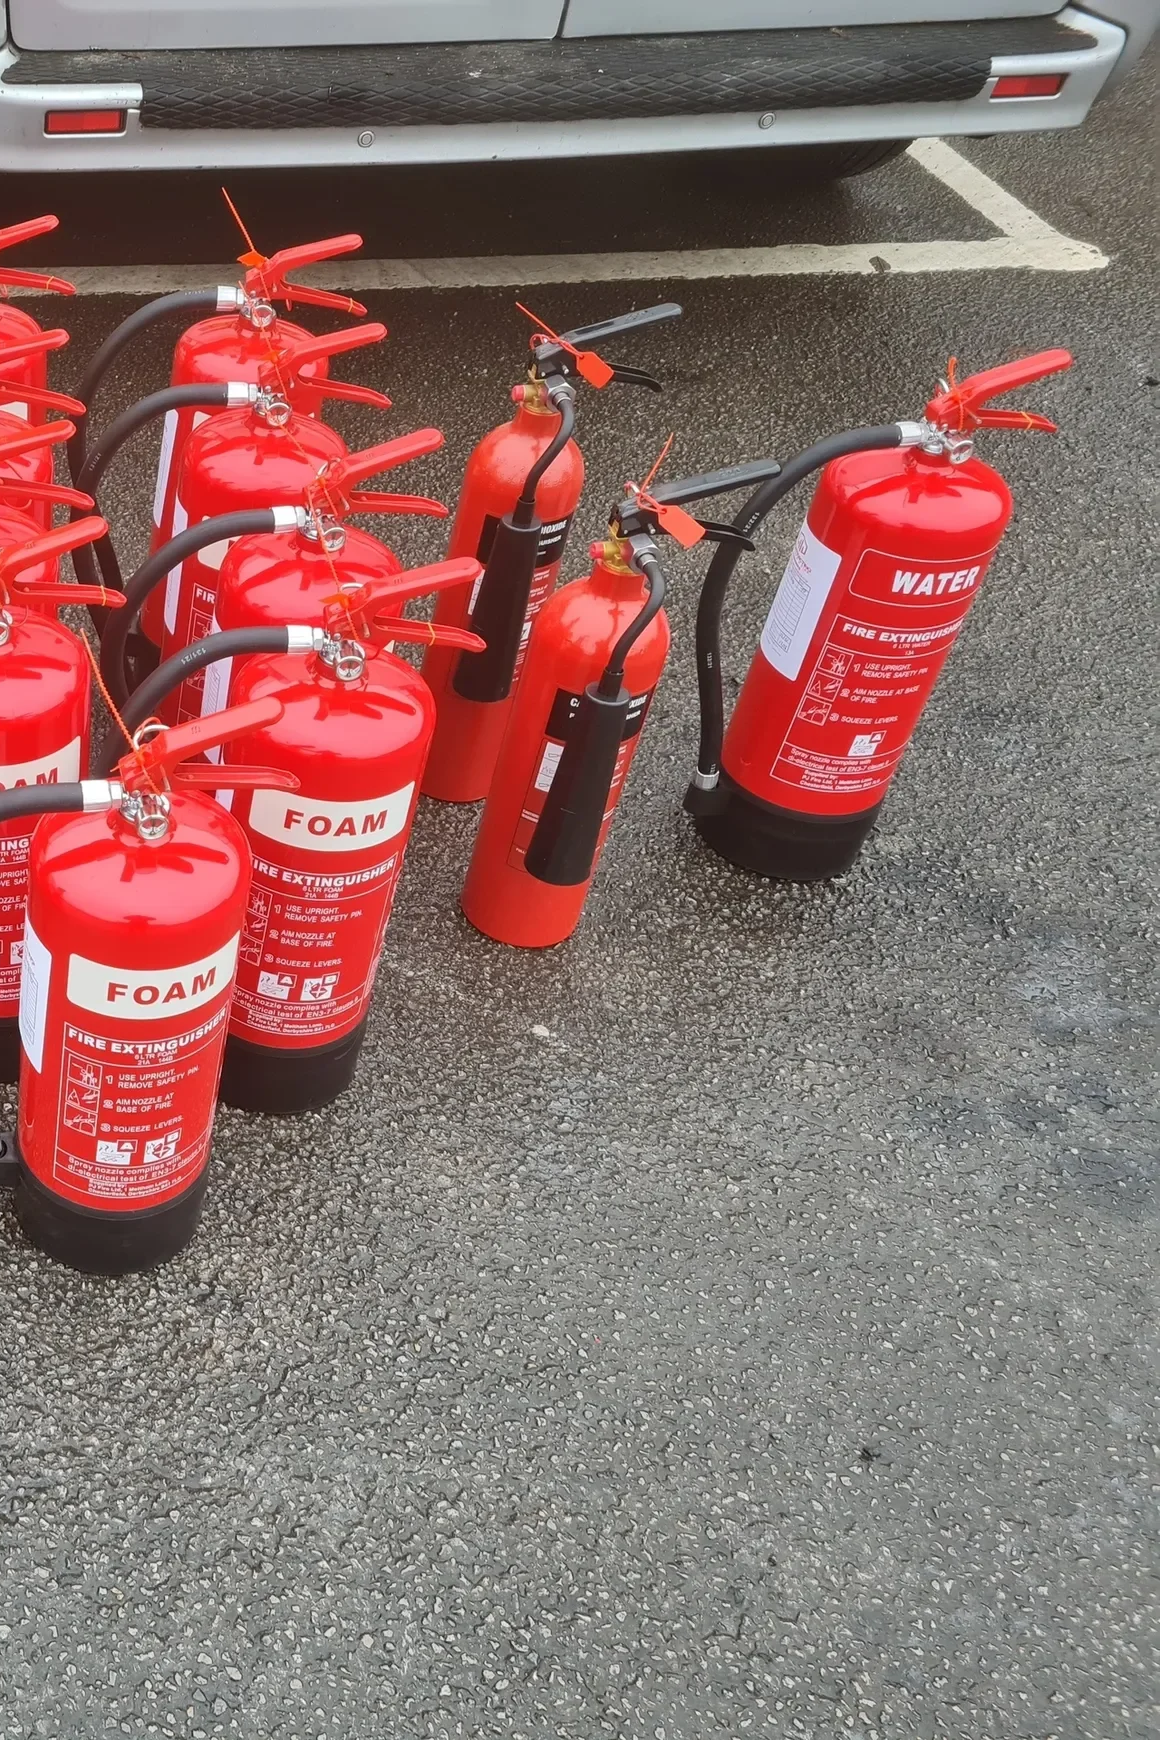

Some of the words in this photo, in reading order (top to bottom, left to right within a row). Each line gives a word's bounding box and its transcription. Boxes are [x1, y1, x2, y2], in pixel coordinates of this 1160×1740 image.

[743, 512, 760, 532] 132/21
[891, 565, 980, 596] WATER
[196, 588, 215, 604] FIR
[843, 622, 875, 639] FIRE
[854, 664, 860, 672] 1
[862, 670, 891, 678] REMOVE
[893, 669, 917, 678] SAFETY
[840, 688, 850, 697] 2
[841, 716, 872, 724] SQUEEZE
[283, 808, 388, 837] FOAM
[11, 848, 29, 856] FOAM
[282, 858, 395, 887] EXTINGUISHER
[274, 904, 281, 913] 1
[286, 904, 302, 913] USE
[285, 913, 317, 923] REMOVE
[320, 913, 348, 923] SAFETY
[269, 930, 279, 939] 2
[281, 930, 295, 938] AIM
[281, 938, 300, 947] BASE
[275, 958, 311, 968] SQUEEZE
[107, 966, 217, 1005] FOAM
[69, 1028, 106, 1050] FIRE
[111, 1008, 226, 1054] EXTINGUISHER
[157, 1049, 177, 1058] FOAM
[106, 1075, 113, 1084] 1
[140, 1069, 176, 1081] UPRIGHT.
[118, 1081, 153, 1089] REMOVE
[157, 1073, 184, 1086] SAFETY
[103, 1100, 113, 1109] 2
[132, 1096, 161, 1105] NOZZLE
[113, 1124, 150, 1133] SQUEEZE
[154, 1115, 184, 1130] LEVERS.
[69, 1156, 92, 1172] Spray
[95, 1167, 124, 1175] nozzle
[126, 1164, 165, 1176] complies
[167, 1156, 181, 1169] with
